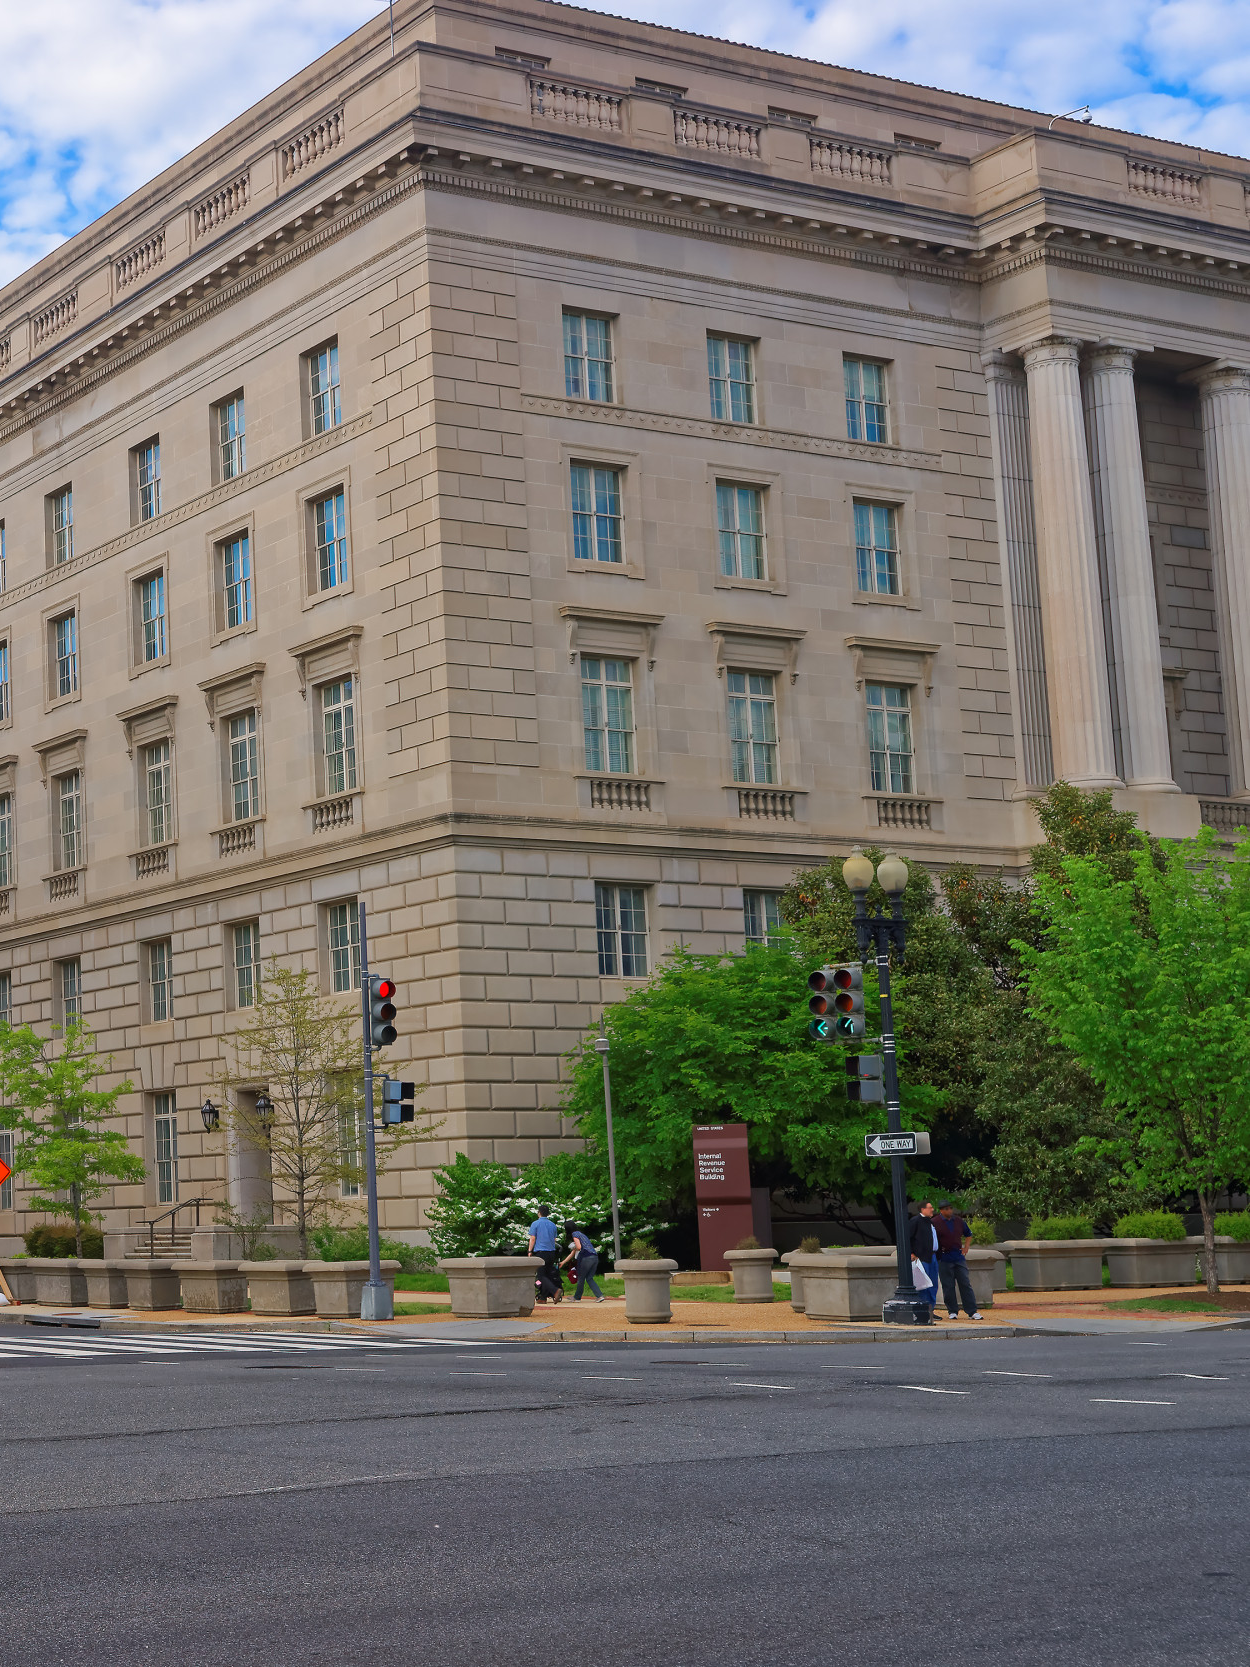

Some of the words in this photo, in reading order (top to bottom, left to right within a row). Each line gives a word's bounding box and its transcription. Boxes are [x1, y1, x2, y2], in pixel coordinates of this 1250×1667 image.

[880, 1141, 894, 1149] ONE
[896, 1140, 910, 1149] WAY
[699, 1173, 725, 1181] Building
